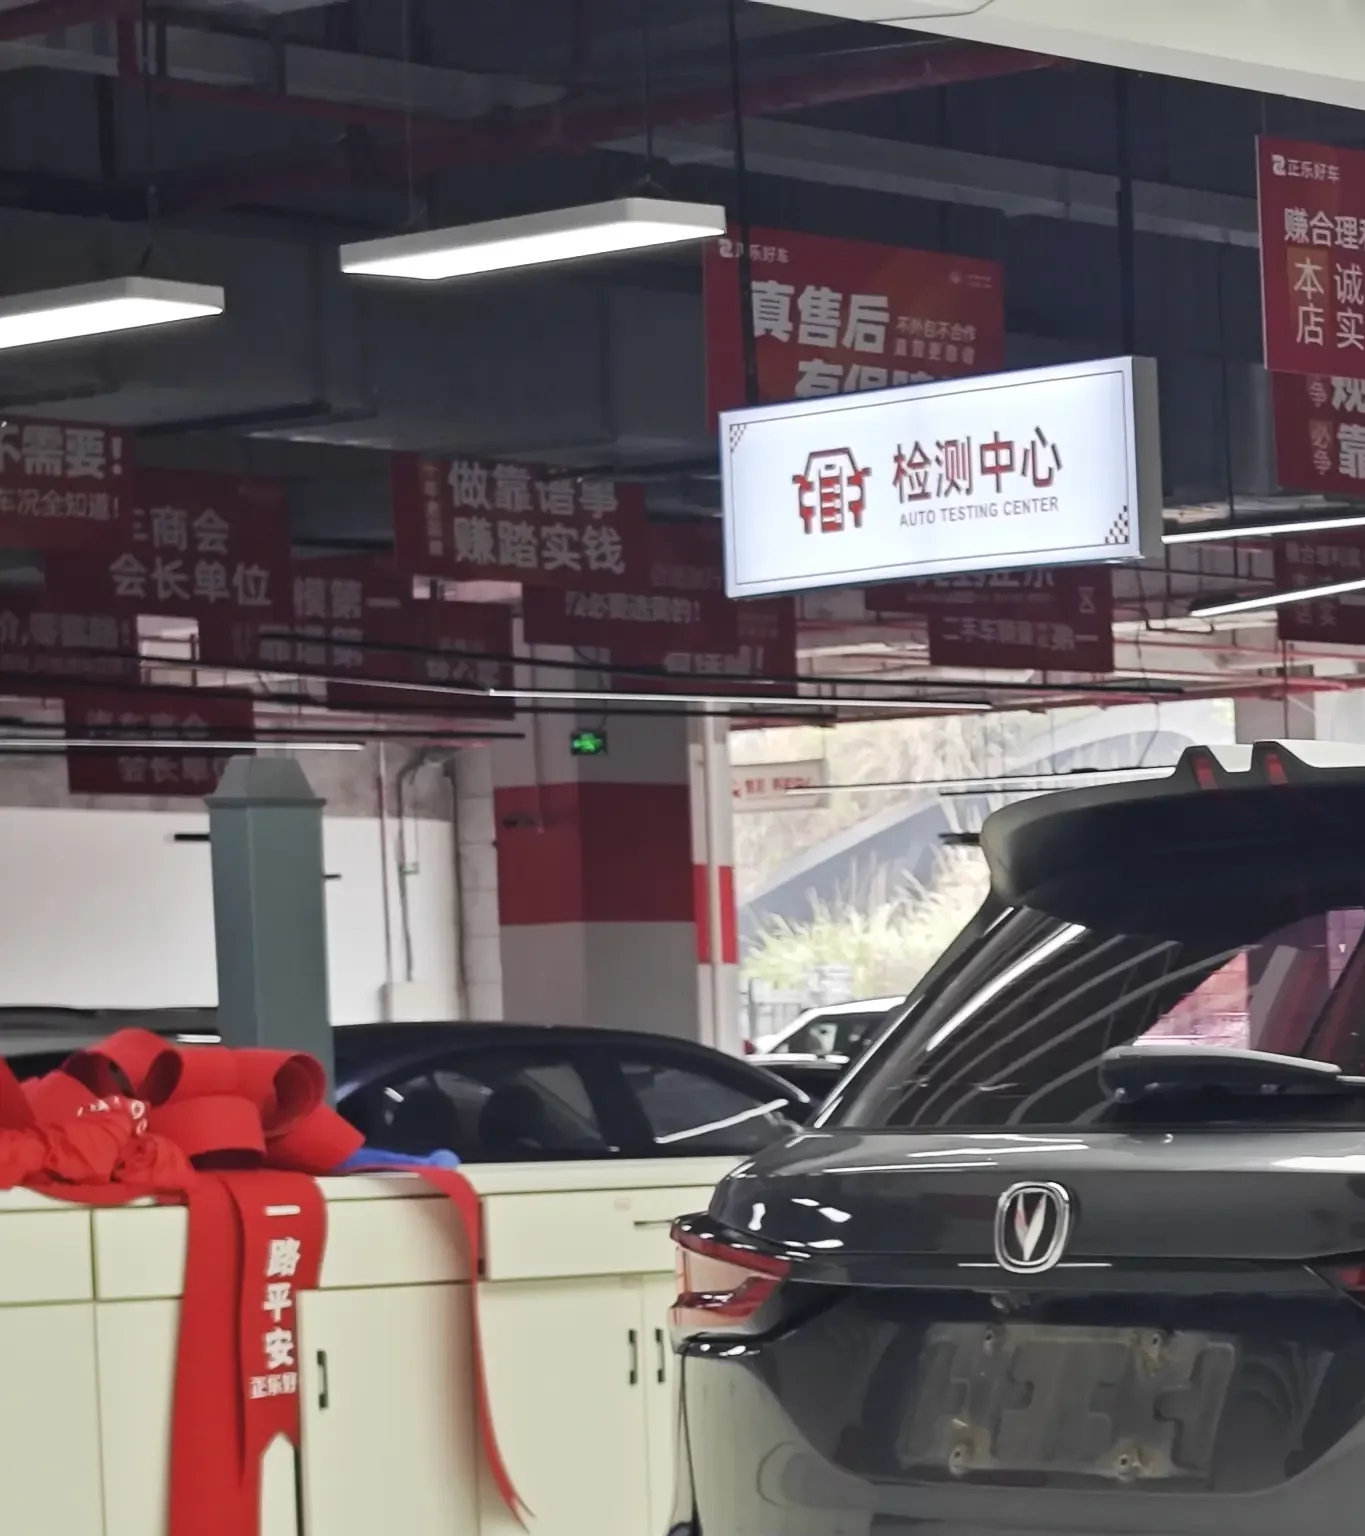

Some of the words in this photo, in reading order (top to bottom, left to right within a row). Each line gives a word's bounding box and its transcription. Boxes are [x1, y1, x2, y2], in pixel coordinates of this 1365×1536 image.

[1287, 158, 1341, 184] 正乐好车
[751, 279, 891, 354] 真售后
[893, 425, 1063, 505] 检测中心
[900, 509, 936, 527] AUTO
[940, 502, 999, 523] TESTING
[1003, 496, 1060, 516] CENTER
[108, 553, 271, 605] 会长单位
[264, 1204, 301, 1369] 一路平安
